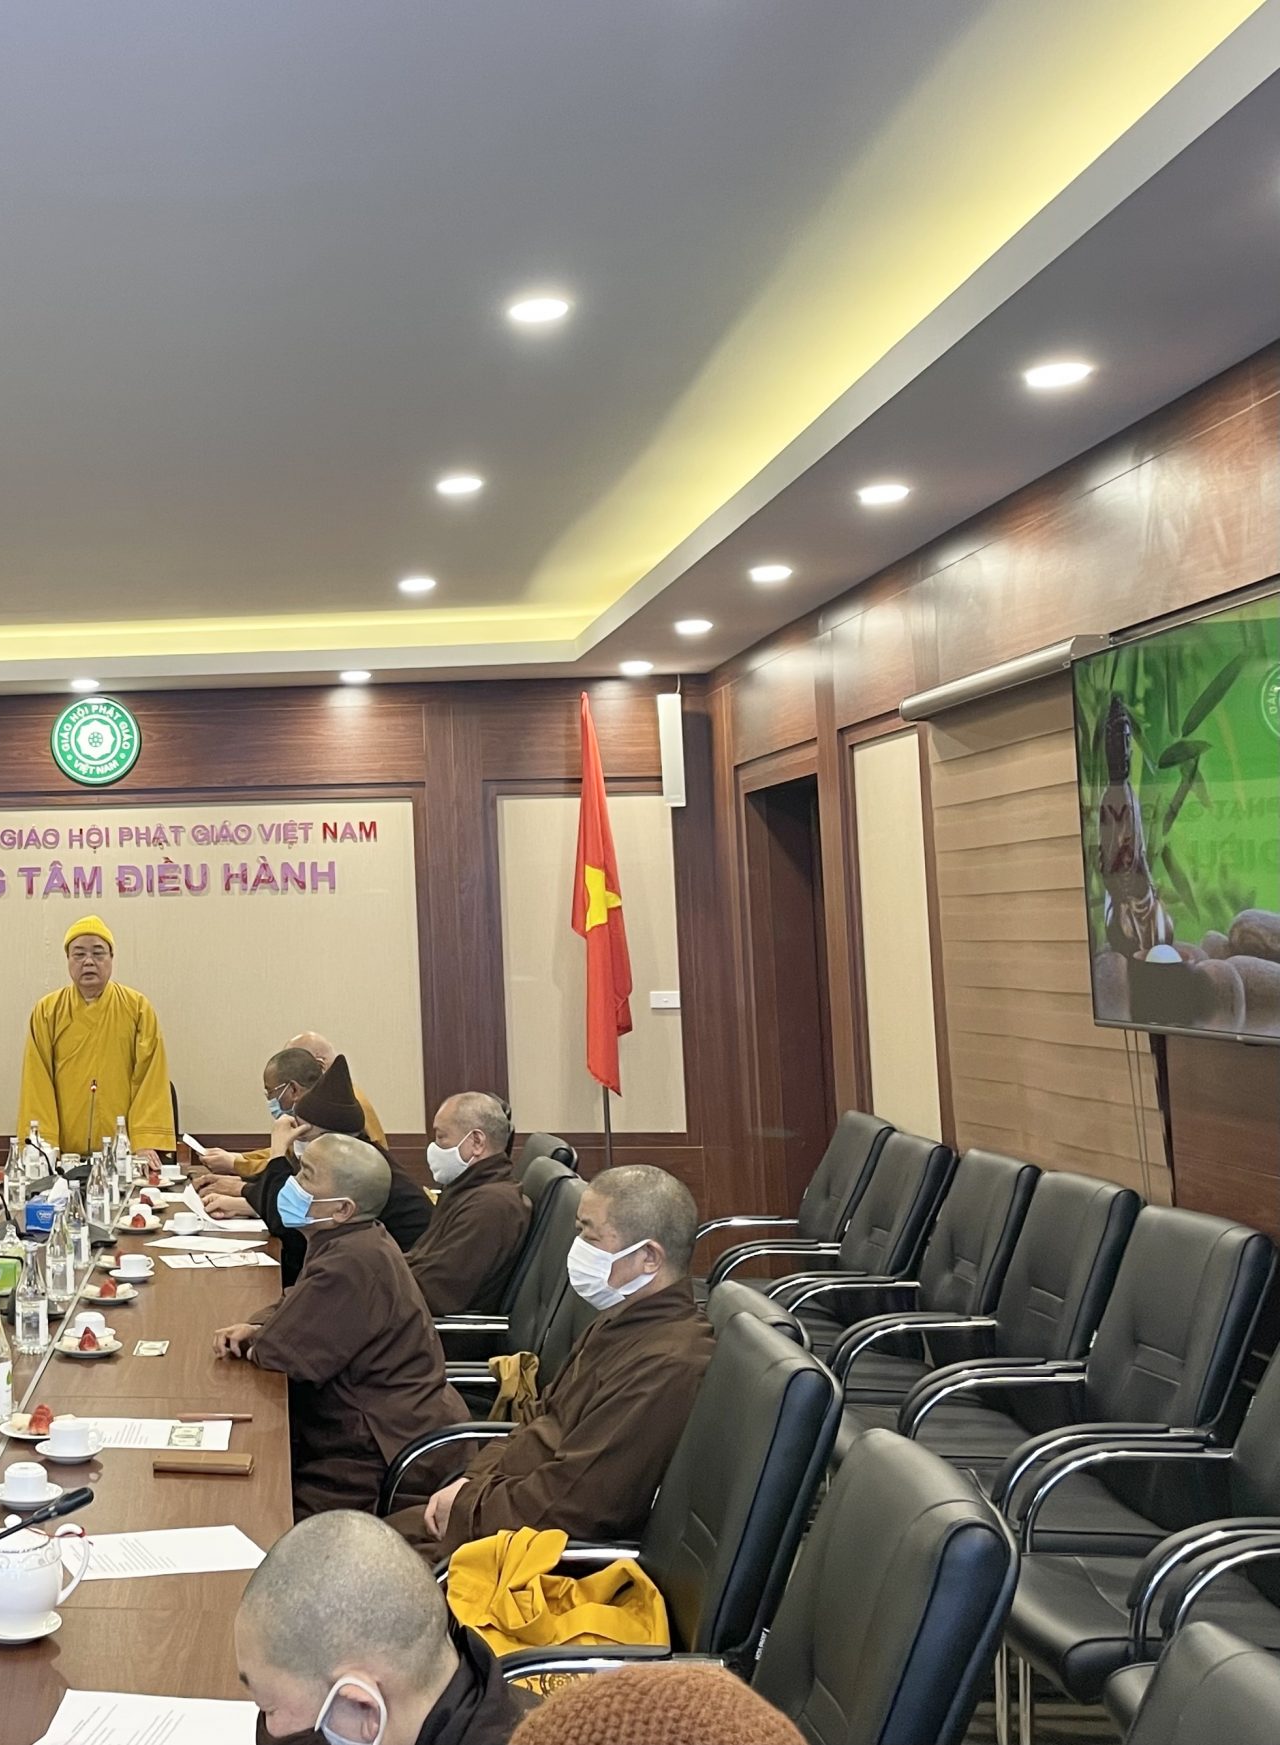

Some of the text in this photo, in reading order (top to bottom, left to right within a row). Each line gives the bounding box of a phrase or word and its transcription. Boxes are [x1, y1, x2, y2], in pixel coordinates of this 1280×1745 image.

[95, 760, 119, 775] NAM
[0, 824, 60, 849] GIÁO
[69, 824, 110, 854] HỘI
[118, 822, 185, 850] PHẬT
[191, 820, 253, 846] GIÁO
[258, 819, 314, 849] VIỆT
[322, 821, 378, 843] NAM
[17, 859, 103, 899] TÂM
[115, 856, 211, 897] ĐIỀU
[222, 855, 337, 896] HÀNH
